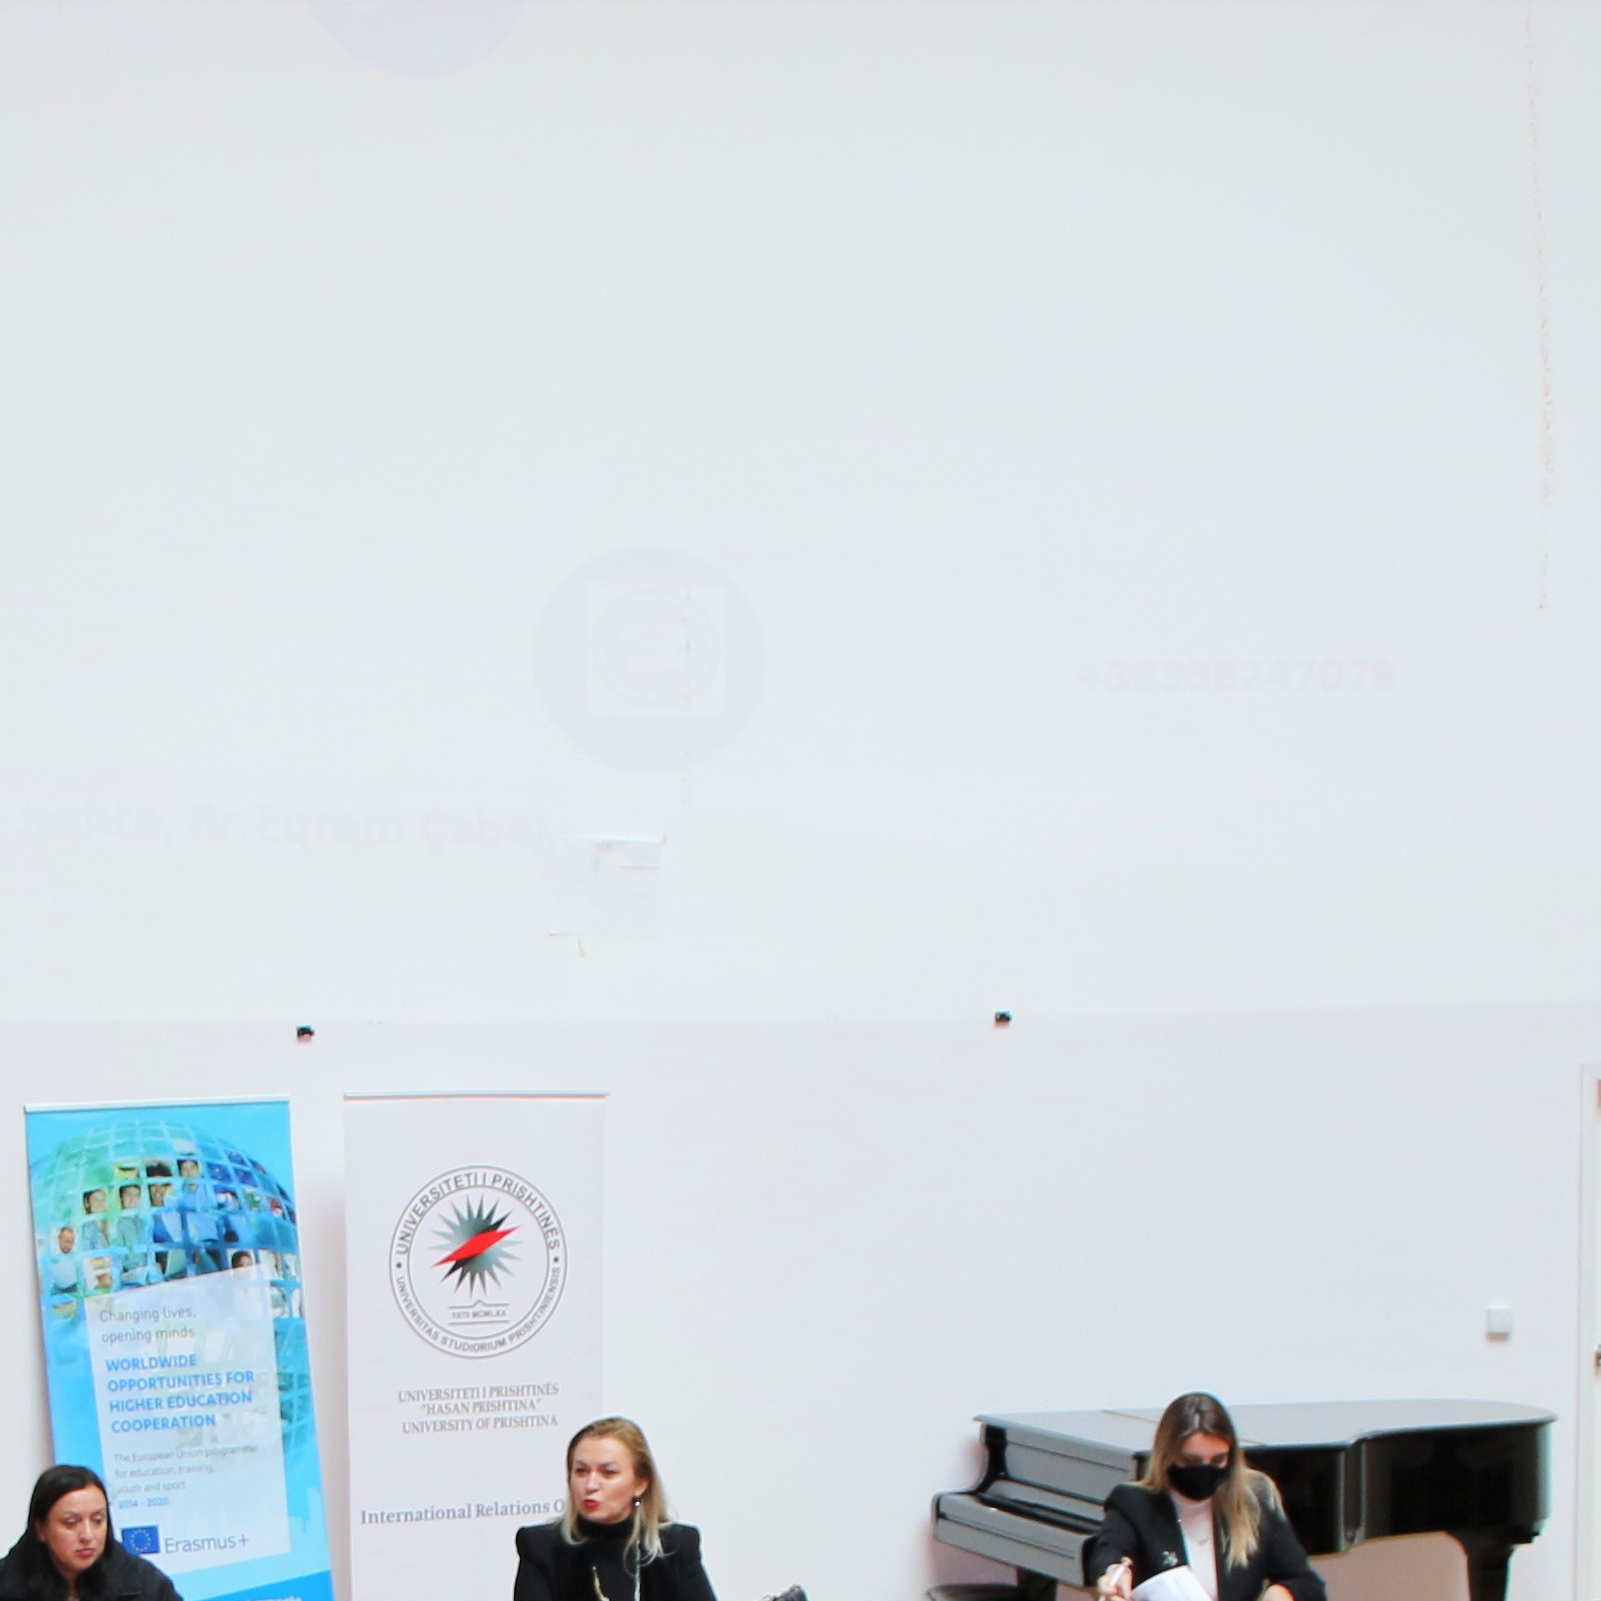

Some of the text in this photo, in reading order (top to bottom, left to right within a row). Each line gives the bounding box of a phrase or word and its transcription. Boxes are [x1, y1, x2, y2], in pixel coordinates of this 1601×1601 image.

[396, 1172, 478, 1255] UNIVERSITETI
[100, 1306, 197, 1325] Changing lives,
[397, 1276, 439, 1340] UNIVERSITAS
[101, 1326, 195, 1345] opening minds
[105, 1354, 197, 1372] WORLDWIDE
[107, 1371, 254, 1392] OPPORTUNITIES FOR
[399, 1386, 481, 1403] UNIVERSITETI
[490, 1381, 560, 1398] PRISHTINËS
[109, 1391, 252, 1413] HIGHER EDUCATION
[111, 1413, 217, 1433] COOPERATION
[402, 1415, 558, 1434] UNIVERSITY OF PRISHTINA
[114, 1453, 130, 1463] The
[132, 1451, 175, 1463] European
[177, 1447, 205, 1458] Union
[115, 1469, 127, 1479] for
[117, 1481, 186, 1495] youth and sport
[147, 1497, 169, 1508] 2020
[360, 1503, 472, 1525] International
[476, 1500, 550, 1518] Relations
[165, 1533, 249, 1554] Erasmus+
